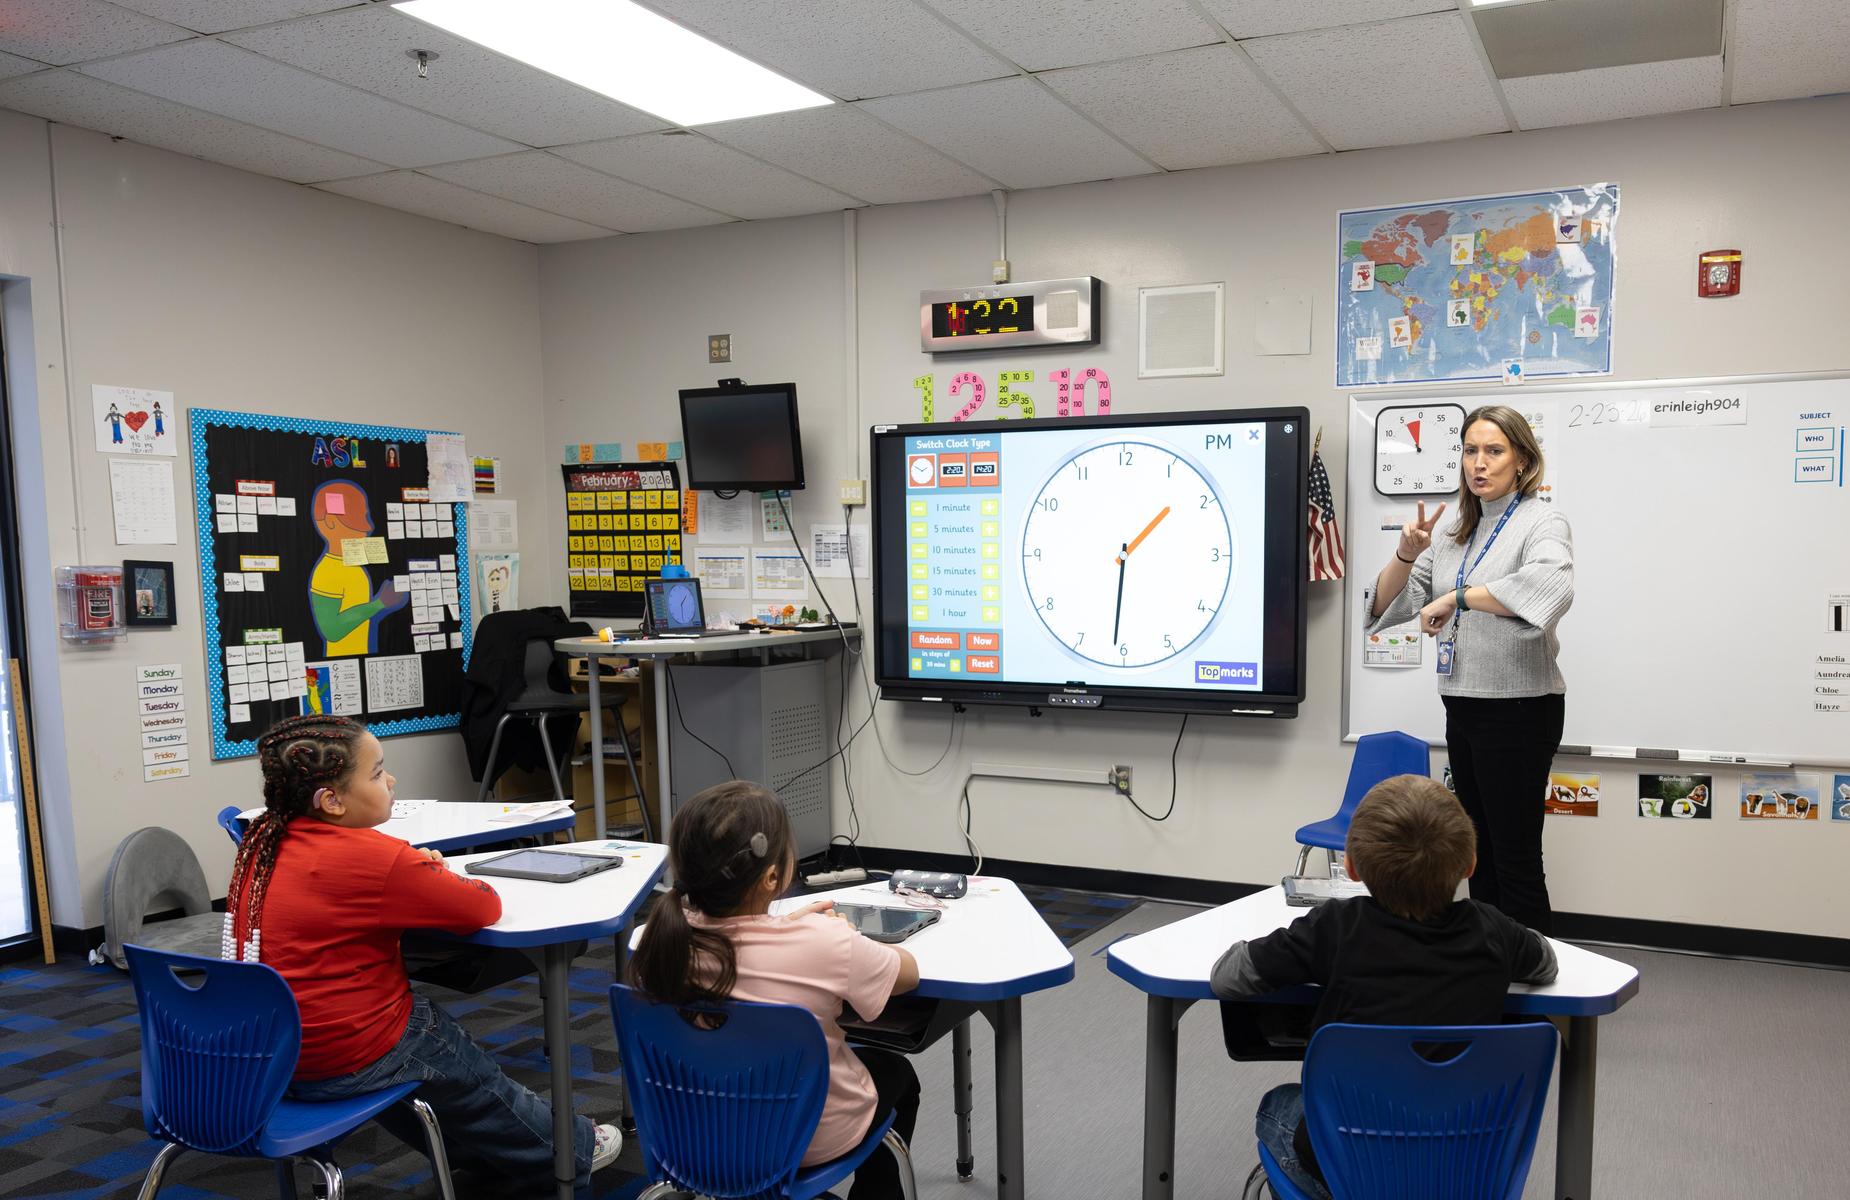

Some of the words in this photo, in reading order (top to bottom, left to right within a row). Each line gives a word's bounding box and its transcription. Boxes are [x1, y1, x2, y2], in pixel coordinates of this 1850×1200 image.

[1654, 398, 1740, 415] erinleigh904
[1800, 412, 1831, 420] SUBJECT
[916, 440, 943, 449] Switch
[946, 439, 969, 448] Clock
[971, 439, 990, 450] Type
[1205, 434, 1232, 450] PM
[311, 437, 367, 468] ASL
[1119, 452, 1133, 466] 12
[1078, 466, 1088, 480] 11
[582, 475, 628, 488] February
[641, 476, 671, 484] 2026
[1414, 482, 1423, 490] 30
[1044, 498, 1058, 511] 10
[1199, 495, 1208, 509] 2
[588, 518, 593, 527] 2
[603, 518, 608, 527] 3
[618, 518, 623, 526] 4
[635, 518, 640, 527] 5
[652, 518, 657, 527] 6
[668, 518, 673, 526] 7
[942, 525, 974, 533] minutes
[573, 539, 579, 547] 8
[589, 539, 594, 547] 9
[602, 539, 611, 547] 10
[618, 539, 626, 547] 11
[633, 539, 642, 547] 12
[649, 539, 659, 547] 13
[933, 546, 940, 554] 10
[944, 546, 976, 554] minutes
[1033, 548, 1042, 561] 9
[1211, 548, 1220, 562] 3
[573, 559, 582, 567] 15
[587, 559, 595, 567] 16
[603, 558, 611, 567] 17
[617, 558, 625, 567] 18
[634, 558, 643, 567] 19
[650, 558, 660, 567] 20
[933, 567, 940, 575] 15
[944, 567, 976, 575] minutes
[573, 579, 582, 587] 22
[588, 579, 597, 587] 23
[603, 579, 611, 587] 24
[619, 580, 628, 588] 25
[634, 580, 644, 588] 26
[932, 588, 942, 596] 30
[945, 588, 977, 596] minutes
[1046, 597, 1054, 610] 8
[1197, 599, 1206, 613] 4
[948, 609, 966, 617] hour
[919, 635, 952, 644] Random
[973, 636, 992, 645] Now
[1077, 633, 1085, 645] 7
[1164, 634, 1172, 648] 5
[1120, 643, 1128, 656] 6
[972, 659, 994, 668] Reset
[1816, 655, 1845, 663] Amelia
[144, 669, 175, 678] Sunday
[1200, 666, 1254, 679] Topmarks
[143, 685, 178, 695] Monday
[145, 701, 179, 711] Tuesday
[1815, 703, 1840, 711] Hayze
[143, 717, 184, 727] Wednesday
[148, 734, 182, 743] Thursday
[154, 751, 177, 760] Friday
